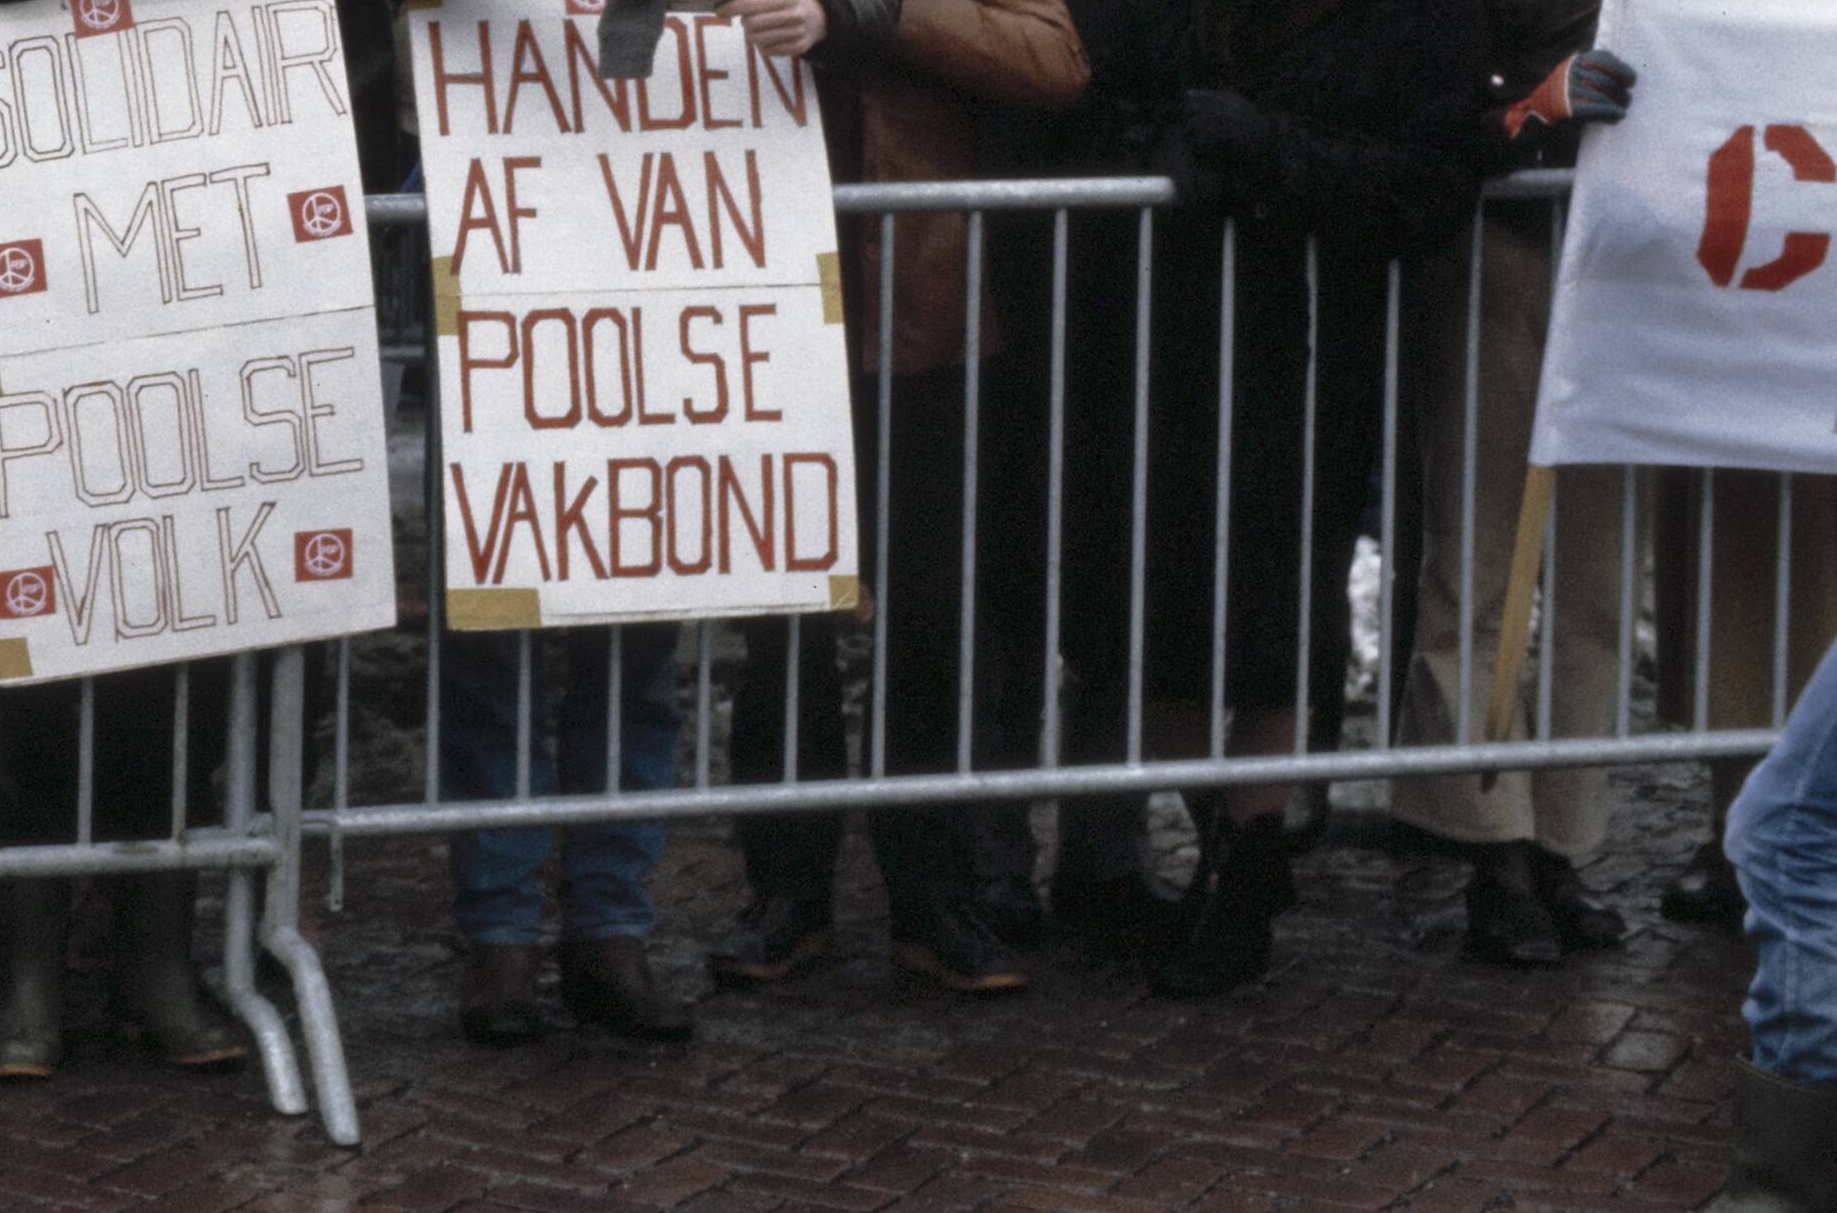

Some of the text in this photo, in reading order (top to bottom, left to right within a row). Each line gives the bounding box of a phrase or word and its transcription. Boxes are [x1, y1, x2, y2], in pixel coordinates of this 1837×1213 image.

[428, 16, 808, 136] HANDEN
[73, 163, 271, 314] MET
[450, 149, 766, 275] AF VAN
[1696, 124, 1837, 292] C
[456, 303, 783, 434] POOLSE
[47, 501, 282, 645] VOLK
[449, 452, 839, 585] VAKBOND
